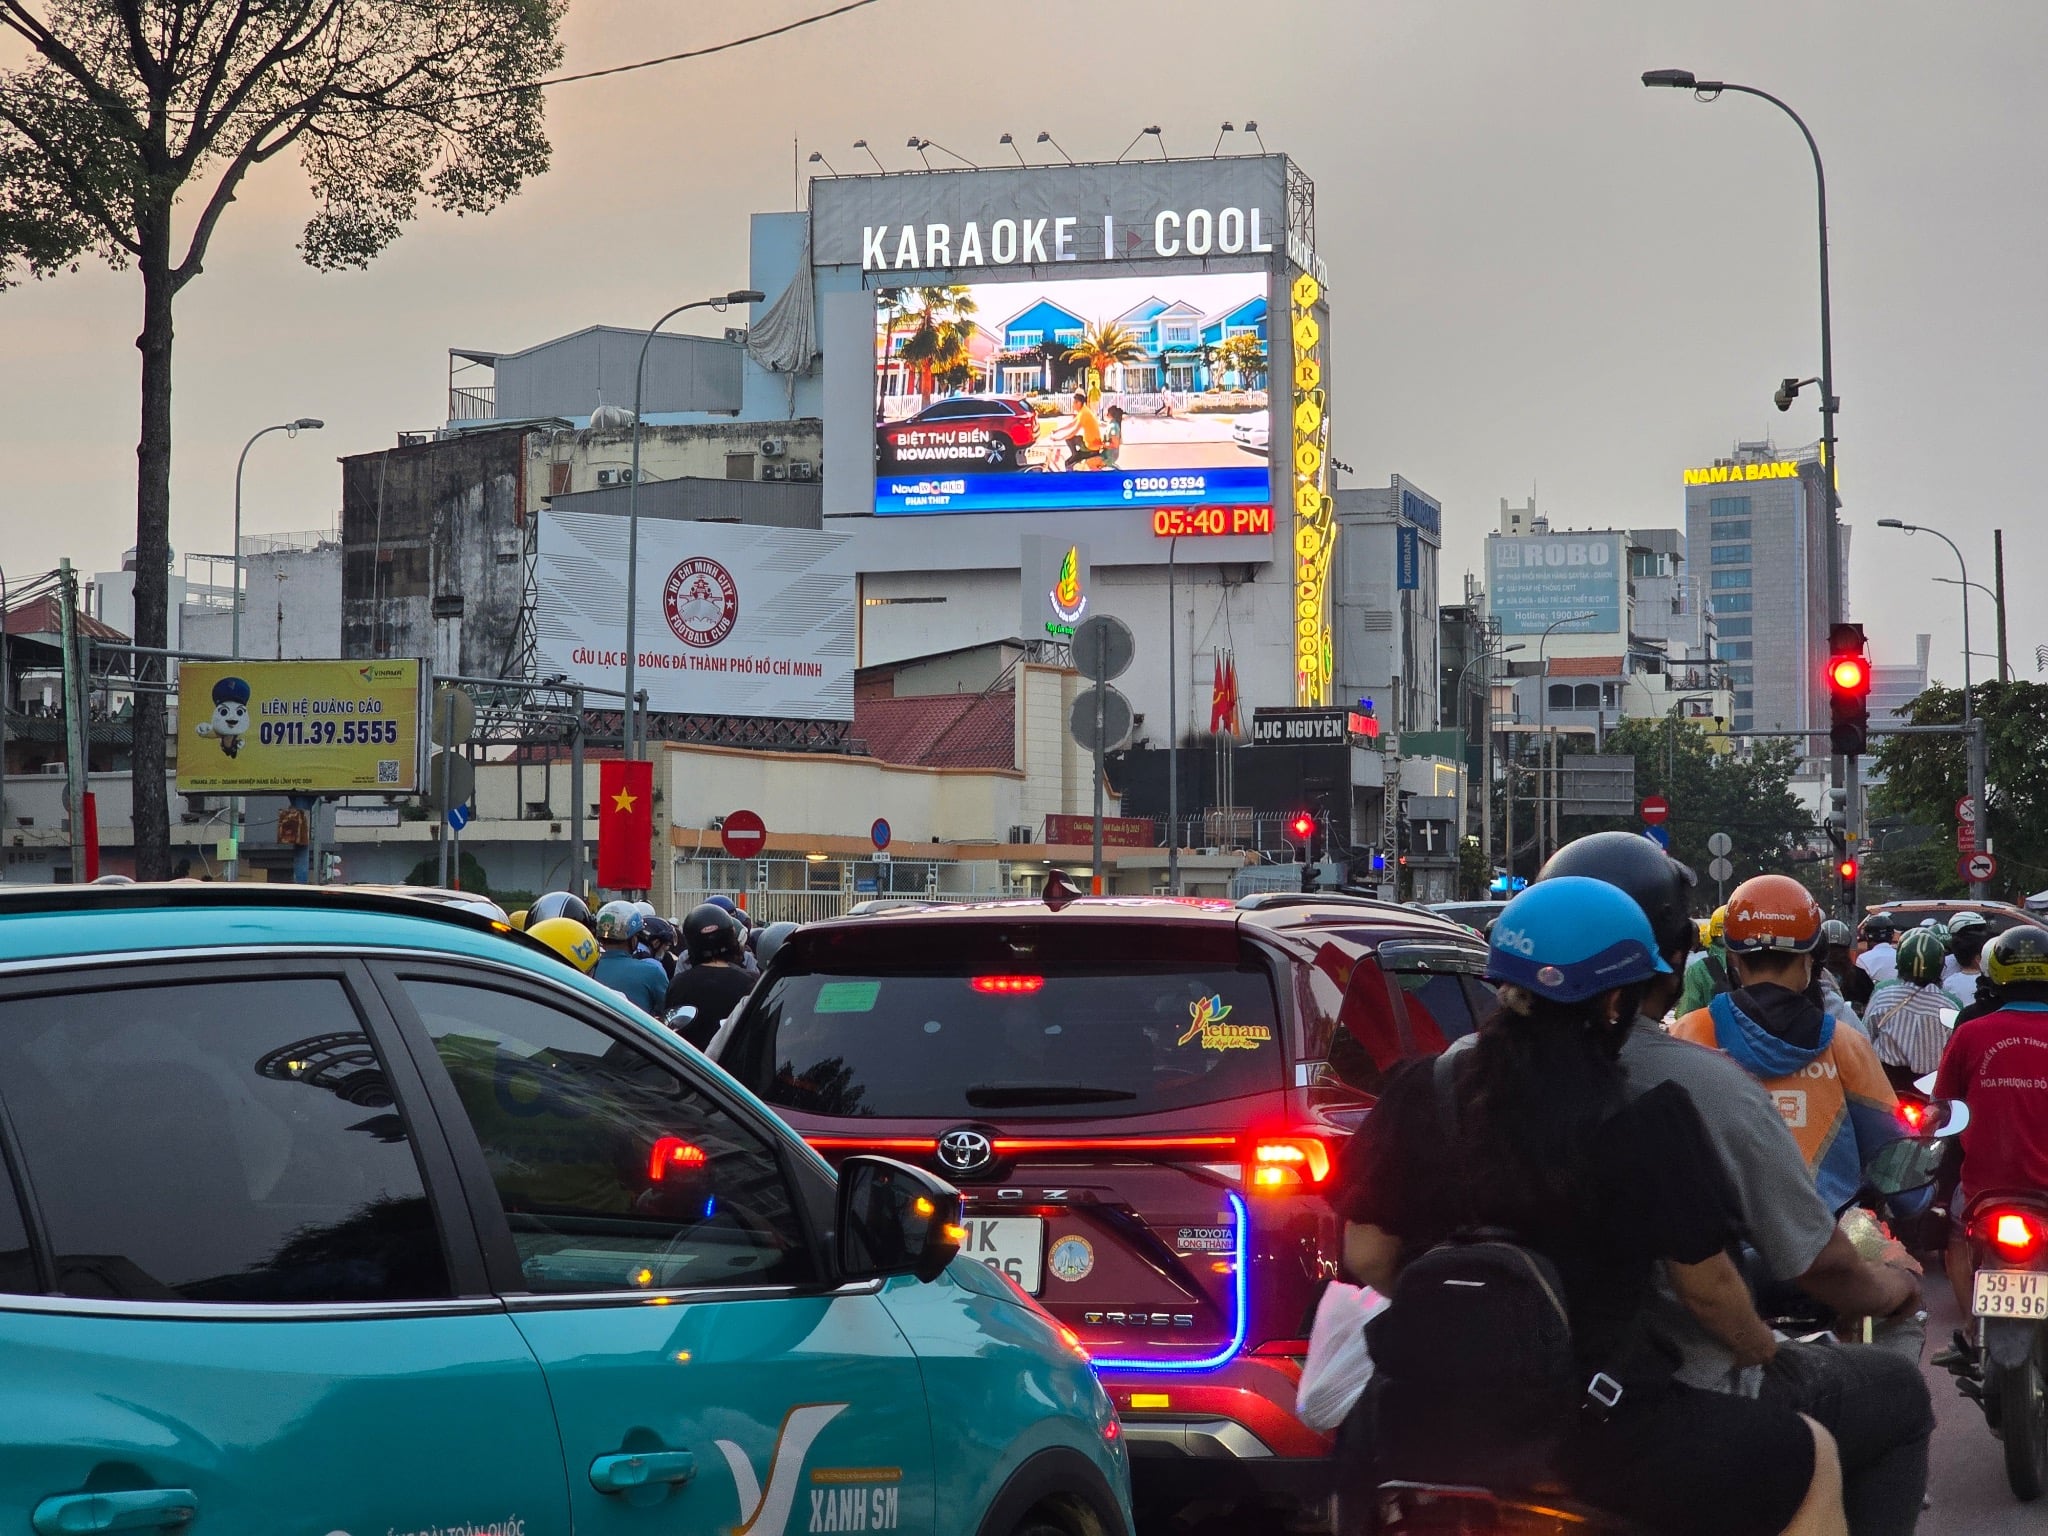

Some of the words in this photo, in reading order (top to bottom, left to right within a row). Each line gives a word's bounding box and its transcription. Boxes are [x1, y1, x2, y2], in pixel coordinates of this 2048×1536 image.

[862, 216, 1077, 270] KARAOKE
[1154, 207, 1273, 257] COOL
[896, 445, 987, 461] NOVAWORLD
[1134, 477, 1168, 490] 1900
[1170, 476, 1205, 490] 9394
[1683, 468, 1727, 485] NAM
[1728, 466, 1744, 482] A
[1745, 461, 1799, 480] BANK
[1154, 510, 1225, 535] 05:40
[1233, 509, 1269, 533] PM
[1403, 533, 1412, 585] EXIMBANK
[1524, 542, 1610, 566] ROBO
[668, 578, 681, 594] HO
[677, 563, 694, 581] CHI
[694, 561, 719, 578] MINH
[717, 574, 734, 596] CITY
[670, 614, 710, 644] FOOTBALL
[710, 617, 731, 640] CLUB
[572, 647, 595, 665] CÂU
[597, 651, 618, 670] LẠC
[620, 652, 636, 667] B
[638, 651, 672, 669] BÓNG
[672, 652, 687, 670] ĐÁ
[689, 654, 727, 673] THÀNH
[730, 656, 752, 674] PHỐ
[755, 657, 771, 675] HỒ
[773, 658, 791, 676] CHÍ
[793, 662, 823, 678] MINH
[261, 698, 288, 715] LIÊN
[292, 698, 308, 718] HỆ
[312, 697, 355, 714] QUẢNG
[358, 696, 382, 713] CÁO
[259, 719, 398, 746] 0911.39.5555
[1254, 720, 1282, 744] LỤC
[1286, 715, 1342, 739] NGUYÊN
[1752, 911, 1796, 921] Ahamove
[1980, 1078, 1997, 1088] HOA
[2034, 1077, 2048, 1090] ĐỎ
[963, 1220, 1000, 1252] 1K
[1179, 1239, 1203, 1249] LONG
[1193, 1228, 1233, 1239] TOYOTA
[1978, 1294, 2045, 1315] 339.96
[1085, 1312, 1193, 1327] CROSS
[809, 1488, 867, 1533] XANH
[871, 1487, 898, 1530] SM
